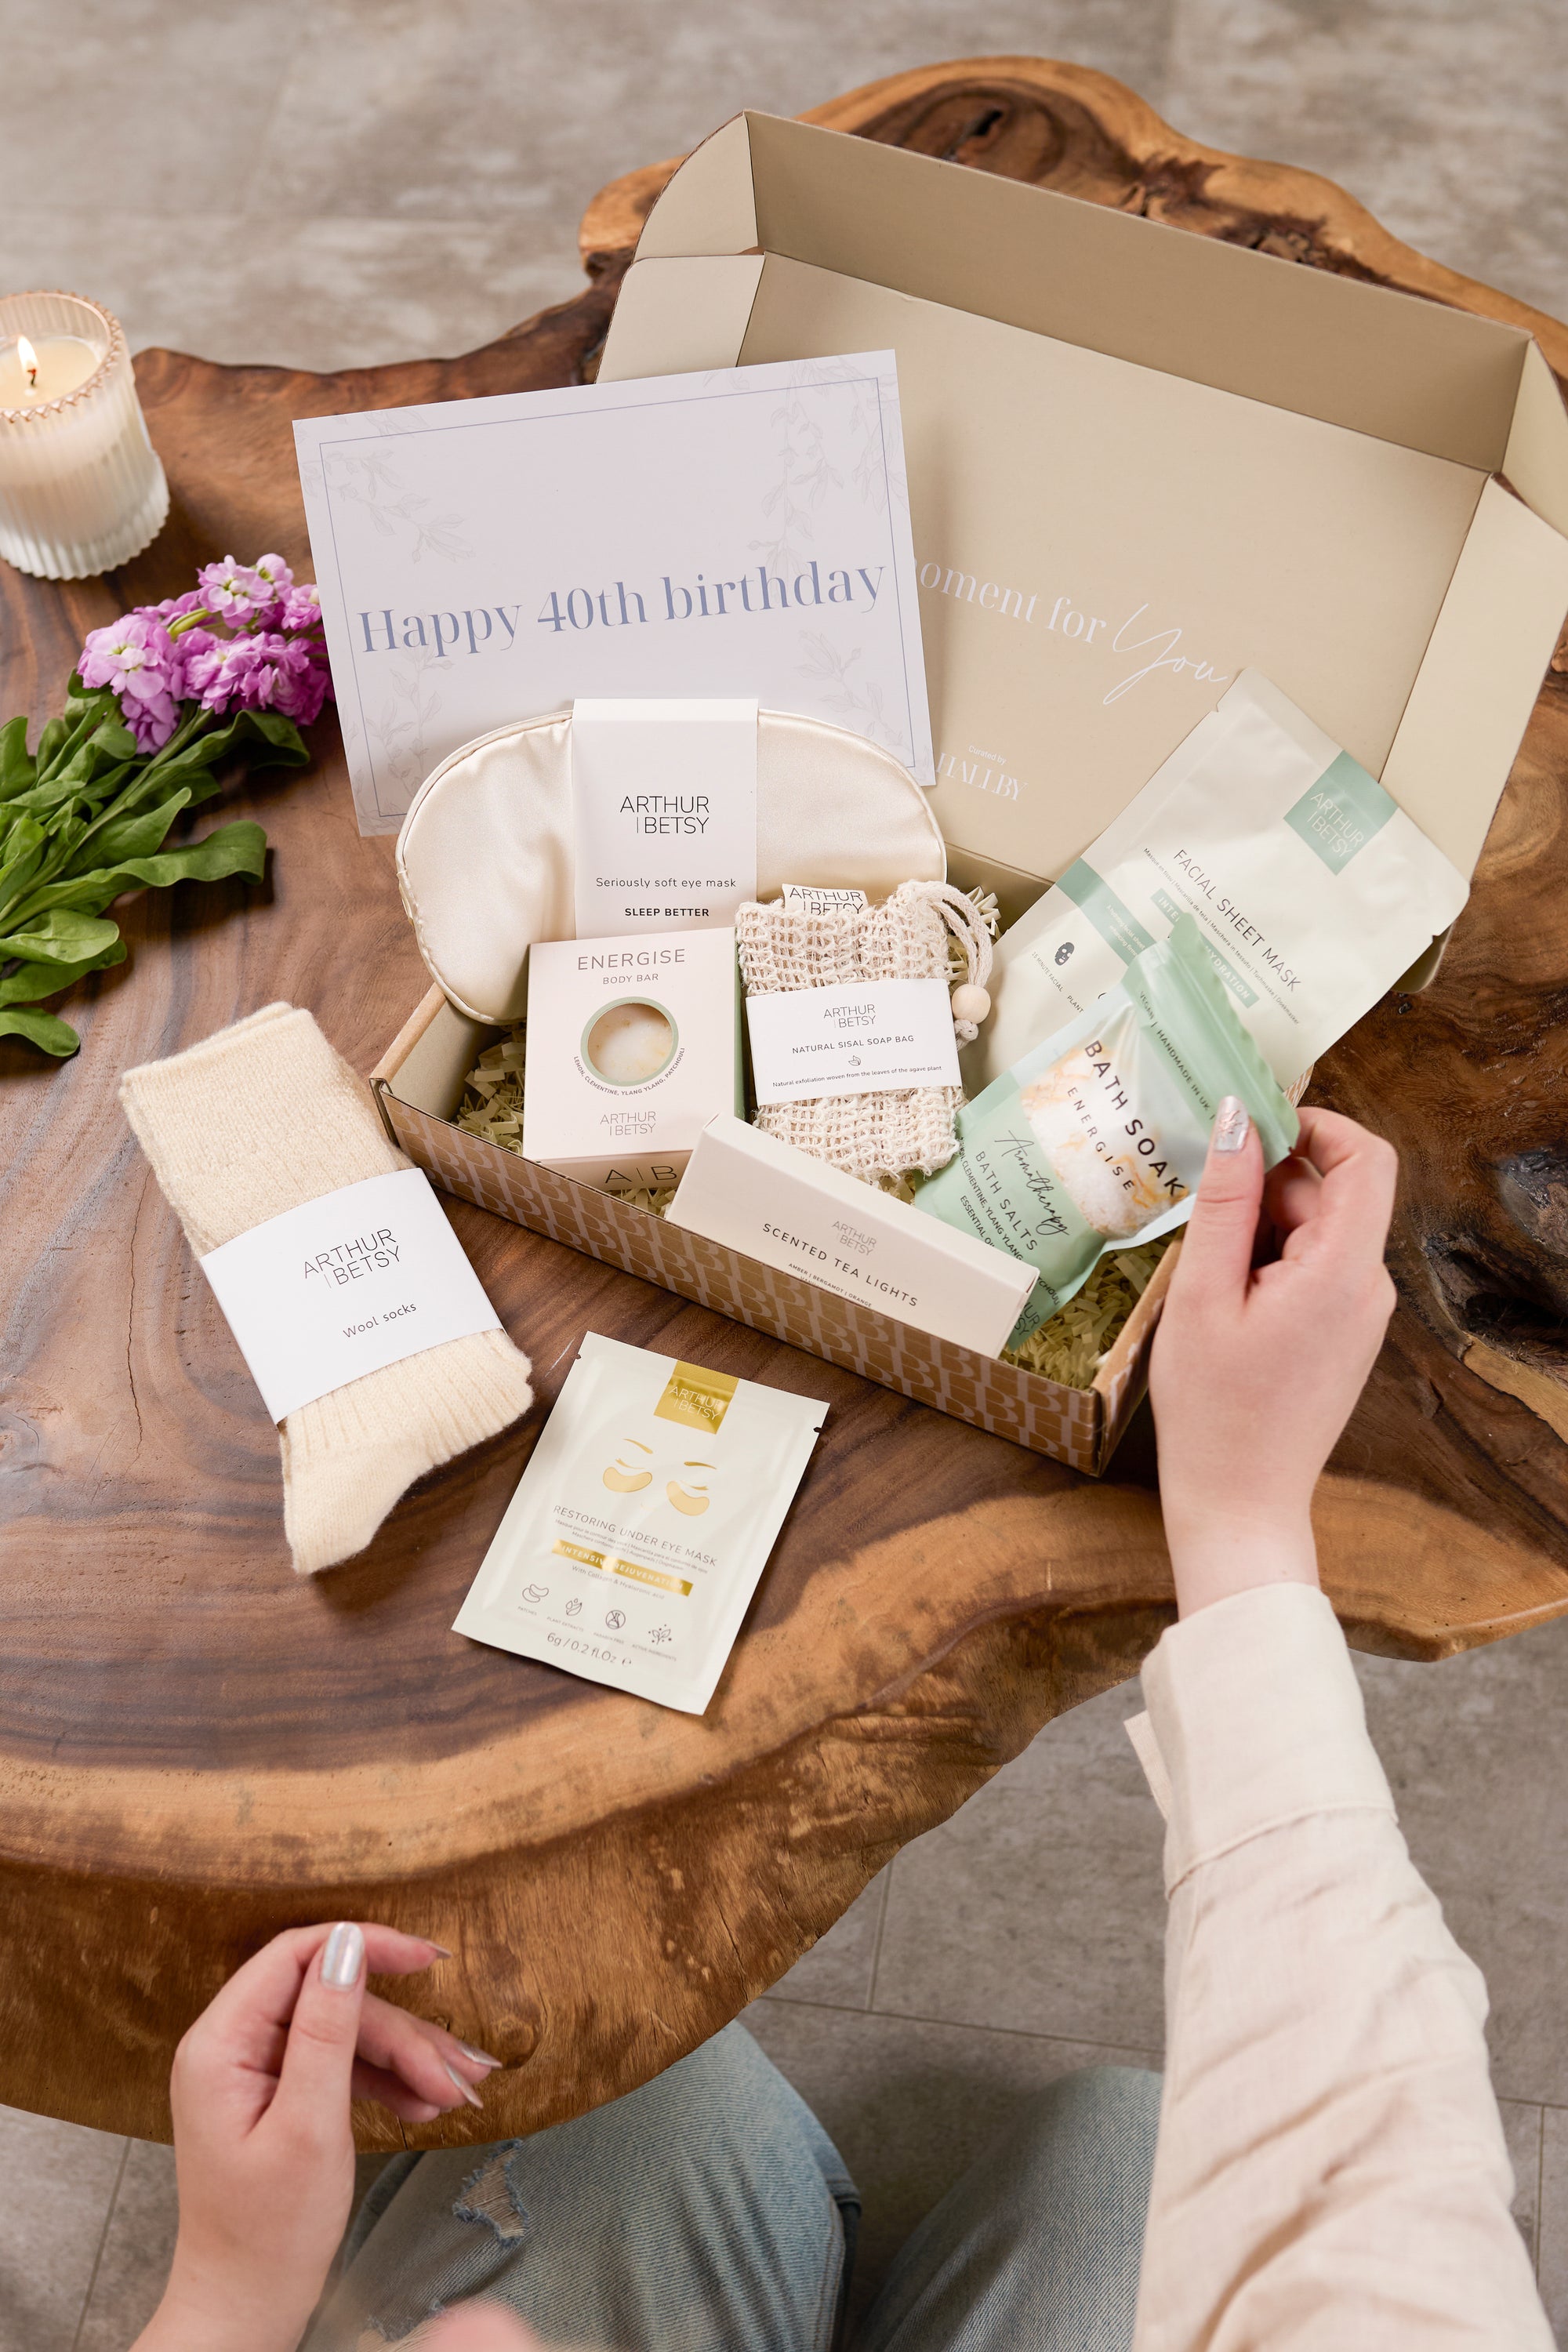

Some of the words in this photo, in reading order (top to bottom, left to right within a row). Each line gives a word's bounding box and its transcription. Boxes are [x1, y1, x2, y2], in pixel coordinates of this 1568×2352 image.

[358, 603, 523, 657] Happy
[537, 581, 650, 633] 40th
[661, 561, 886, 622] birthday
[914, 557, 1044, 624] oment
[1047, 596, 1107, 644] for
[1103, 603, 1229, 705] You
[968, 745, 996, 760] Curated
[997, 754, 1007, 765] by
[935, 752, 1029, 801] HALLBY
[620, 796, 710, 813] ARTHUR
[1310, 792, 1364, 848] ARTHUR
[644, 816, 710, 833] BETSY
[1312, 815, 1353, 858] BETSY
[596, 877, 650, 889] Seriously
[655, 877, 677, 887] soft
[681, 879, 702, 888] eye
[706, 878, 736, 887] mask
[789, 887, 863, 902] ARTHUR
[625, 908, 660, 916] SLEEP
[666, 908, 710, 916] BETTER
[1144, 848, 1160, 866] Masque
[1174, 882, 1193, 906] Mascarilla
[1199, 910, 1208, 921] tela
[1210, 922, 1231, 946] Maschera
[1235, 947, 1251, 969] tessuto
[1173, 849, 1217, 900] FACIAL
[1217, 898, 1265, 947] SHEET
[1261, 947, 1301, 992] MASK
[578, 949, 686, 971] ENERGISE
[603, 975, 633, 985] BODY
[637, 973, 659, 982] BAR
[1036, 956, 1050, 975] MINUTE
[1048, 973, 1063, 993] FACIAL
[1067, 995, 1084, 1013] PLANT
[823, 1004, 877, 1019] ARTHUR
[838, 1015, 877, 1029] BETSY
[792, 1042, 835, 1054] NATURAL
[838, 1039, 864, 1049] SISAL
[867, 1036, 892, 1046] SOAP
[895, 1034, 915, 1044] BAG
[574, 1055, 586, 1077] LEMON,
[584, 1076, 619, 1096] CLEMENTINE,
[644, 1078, 666, 1092] YLANG,
[665, 1047, 685, 1079] PATCHOULI
[795, 1076, 825, 1085] exfoliation
[927, 1065, 942, 1073] plant
[1156, 1029, 1192, 1083] HANDMADE
[1191, 1084, 1200, 1096] IN
[1199, 1097, 1210, 1110] UK
[600, 1111, 656, 1125] ARTHUR
[615, 1123, 656, 1136] BETSY
[1083, 1040, 1129, 1112] BATH
[1124, 1118, 1185, 1198] SOAK
[1066, 1087, 1133, 1192] ENERGISE
[975, 1151, 1002, 1194] BATH
[1000, 1199, 1038, 1250] SALTS
[994, 1130, 1070, 1236] Aromatherapy
[960, 1195, 985, 1238] ESSENTIAL
[961, 1160, 989, 1209] CLEMENTINE,
[985, 1207, 1004, 1236] YLANG
[1002, 1233, 1024, 1261] YLANG
[831, 1221, 877, 1248] ARTHUR
[840, 1234, 874, 1256] BETSY
[303, 1229, 397, 1279] ARTHUR
[332, 1245, 401, 1285] BETSY
[762, 1222, 827, 1261] SCENTED
[834, 1258, 858, 1278] TEA
[866, 1274, 918, 1307] LIGHTS
[788, 1262, 808, 1276] AMBER
[812, 1275, 844, 1294] BERGAMOT
[848, 1293, 873, 1308] ORANGE
[343, 1316, 379, 1338] Wool
[383, 1303, 416, 1322] socks
[669, 1385, 721, 1410] ARTHUR
[678, 1399, 720, 1421] BETSY
[553, 1504, 617, 1534] RESTORING
[619, 1527, 659, 1547] UNDER
[661, 1538, 682, 1555] EYE
[684, 1548, 718, 1567] MASK
[572, 1565, 586, 1576] With
[619, 1581, 652, 1597] Hyaluronic
[546, 1632, 562, 1647] 6g
[571, 1640, 590, 1654] 0.2
[591, 1646, 617, 1664] fl.Oz
